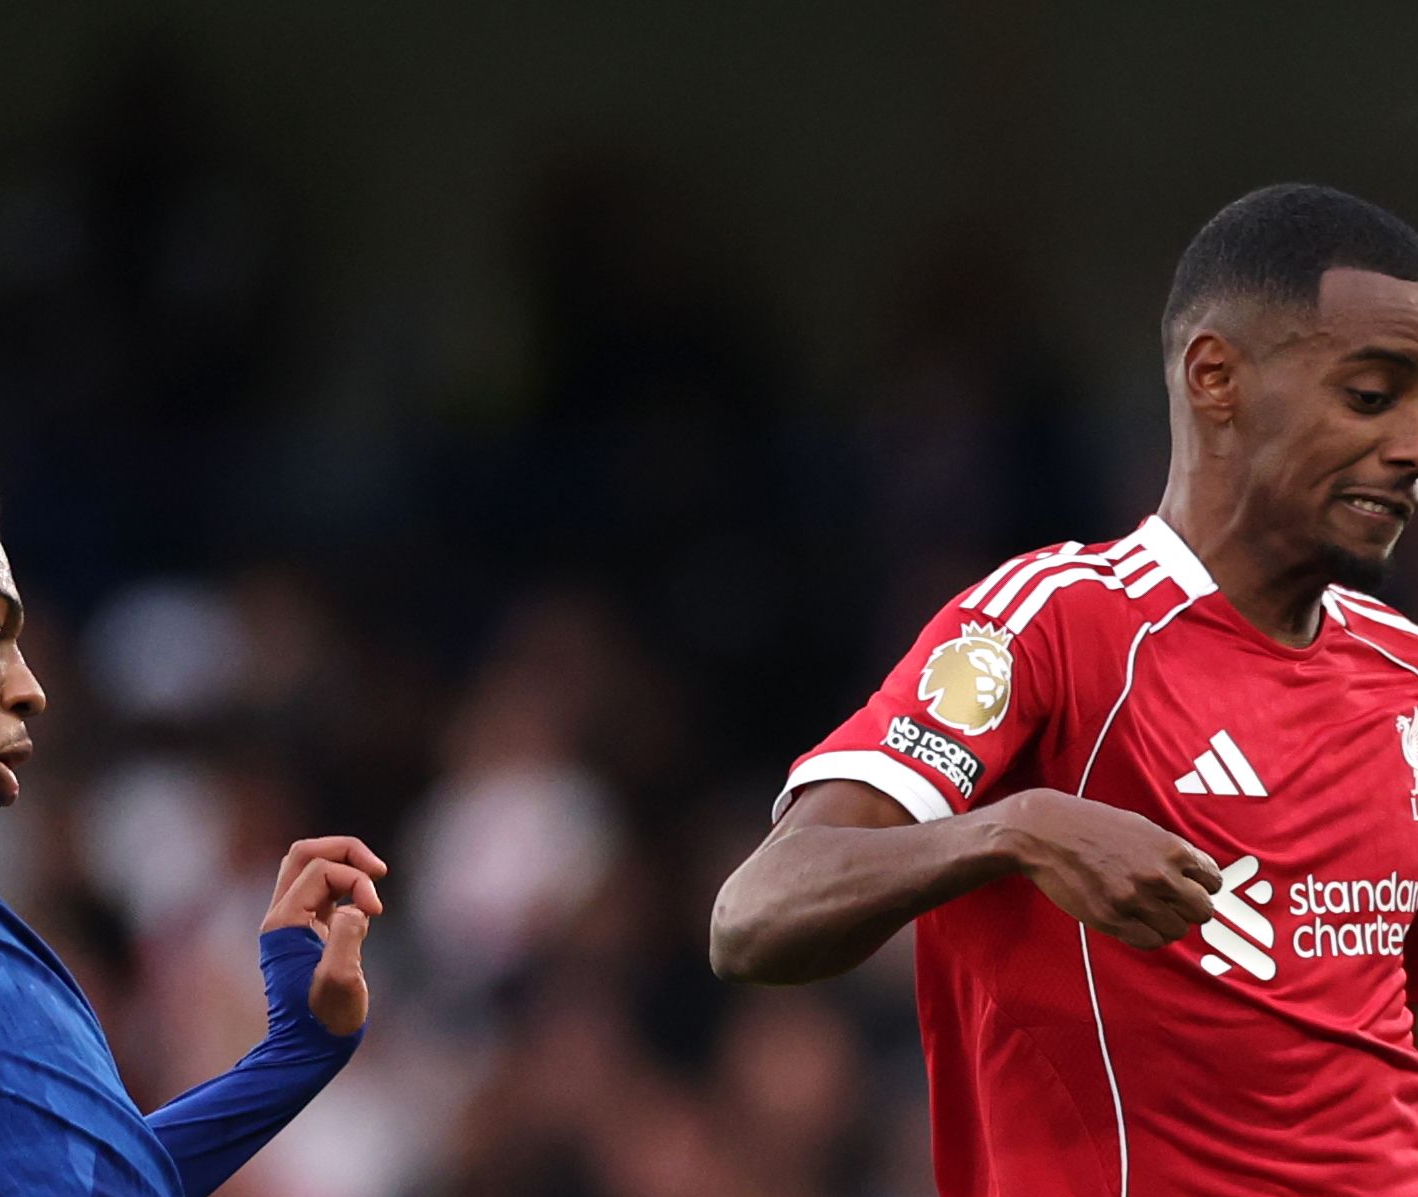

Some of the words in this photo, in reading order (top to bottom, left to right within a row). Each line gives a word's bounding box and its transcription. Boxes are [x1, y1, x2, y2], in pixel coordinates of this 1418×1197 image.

[887, 716, 921, 741] No
[920, 731, 978, 778] room
[912, 744, 973, 799] racism
